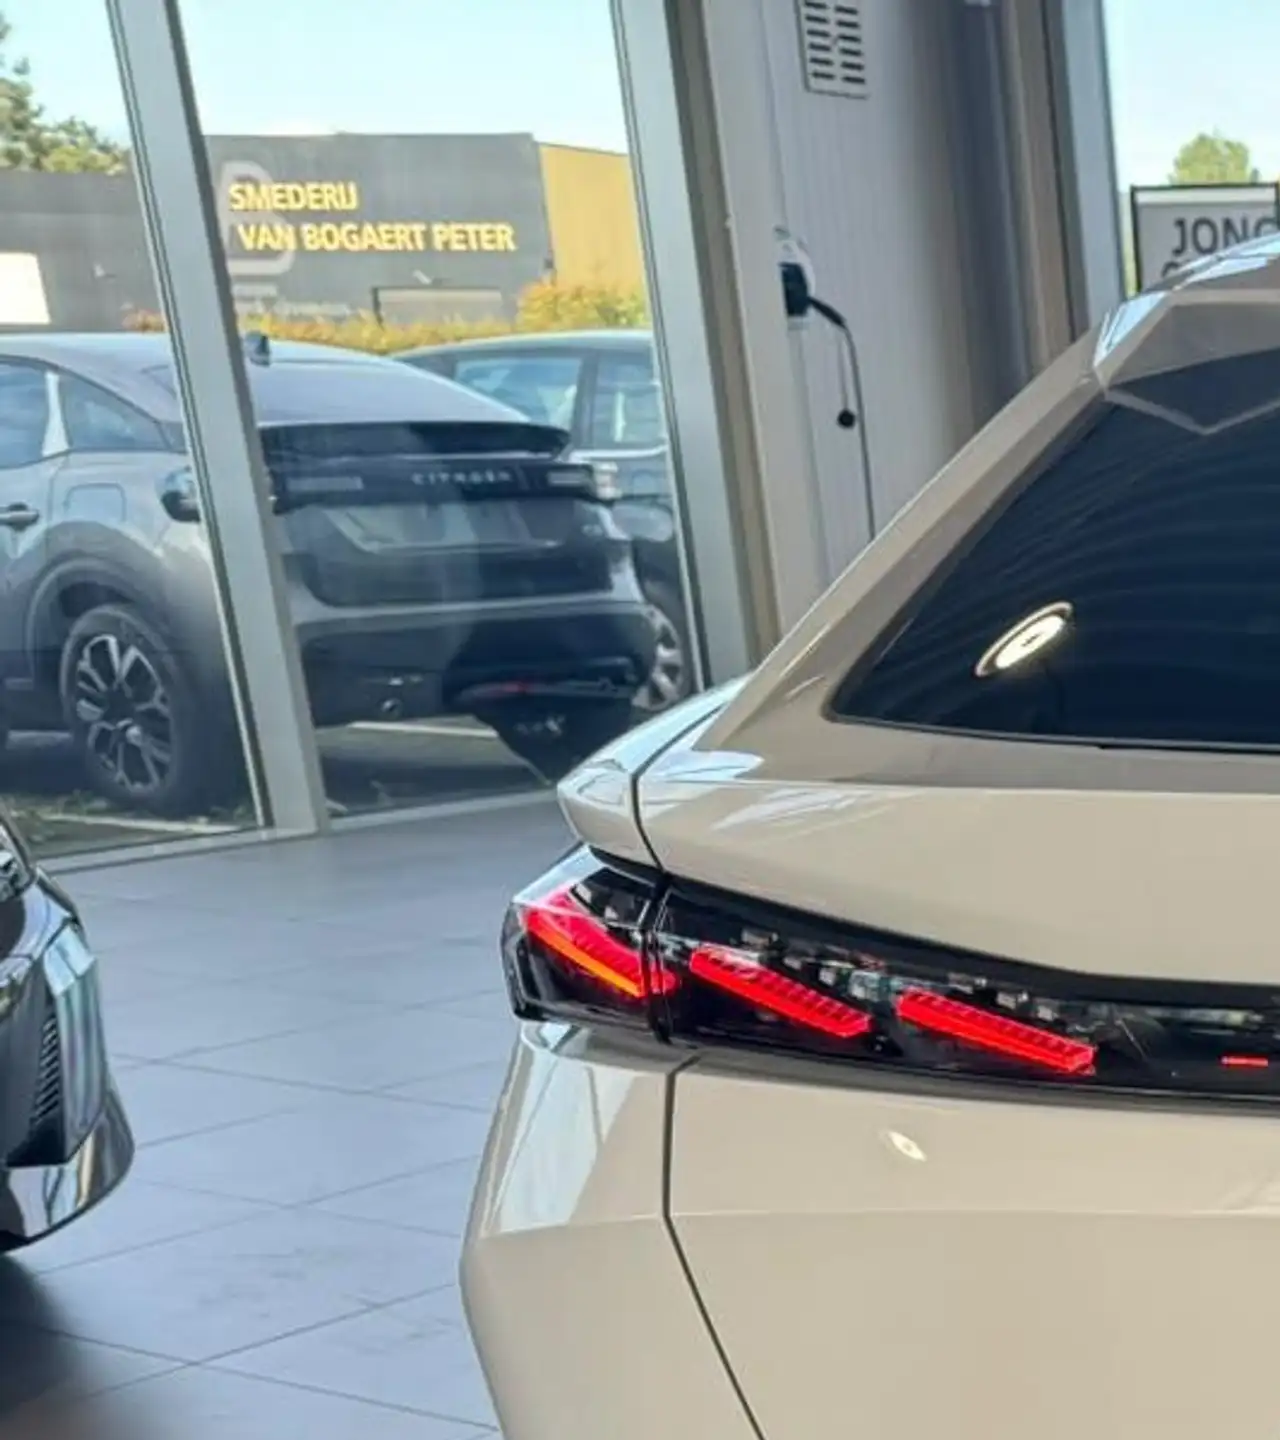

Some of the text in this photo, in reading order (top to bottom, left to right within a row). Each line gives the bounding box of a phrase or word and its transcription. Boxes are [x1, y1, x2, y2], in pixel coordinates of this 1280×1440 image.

[229, 181, 358, 210] SMEDERIJ
[238, 222, 516, 251] VAN BOGAERT PETER
